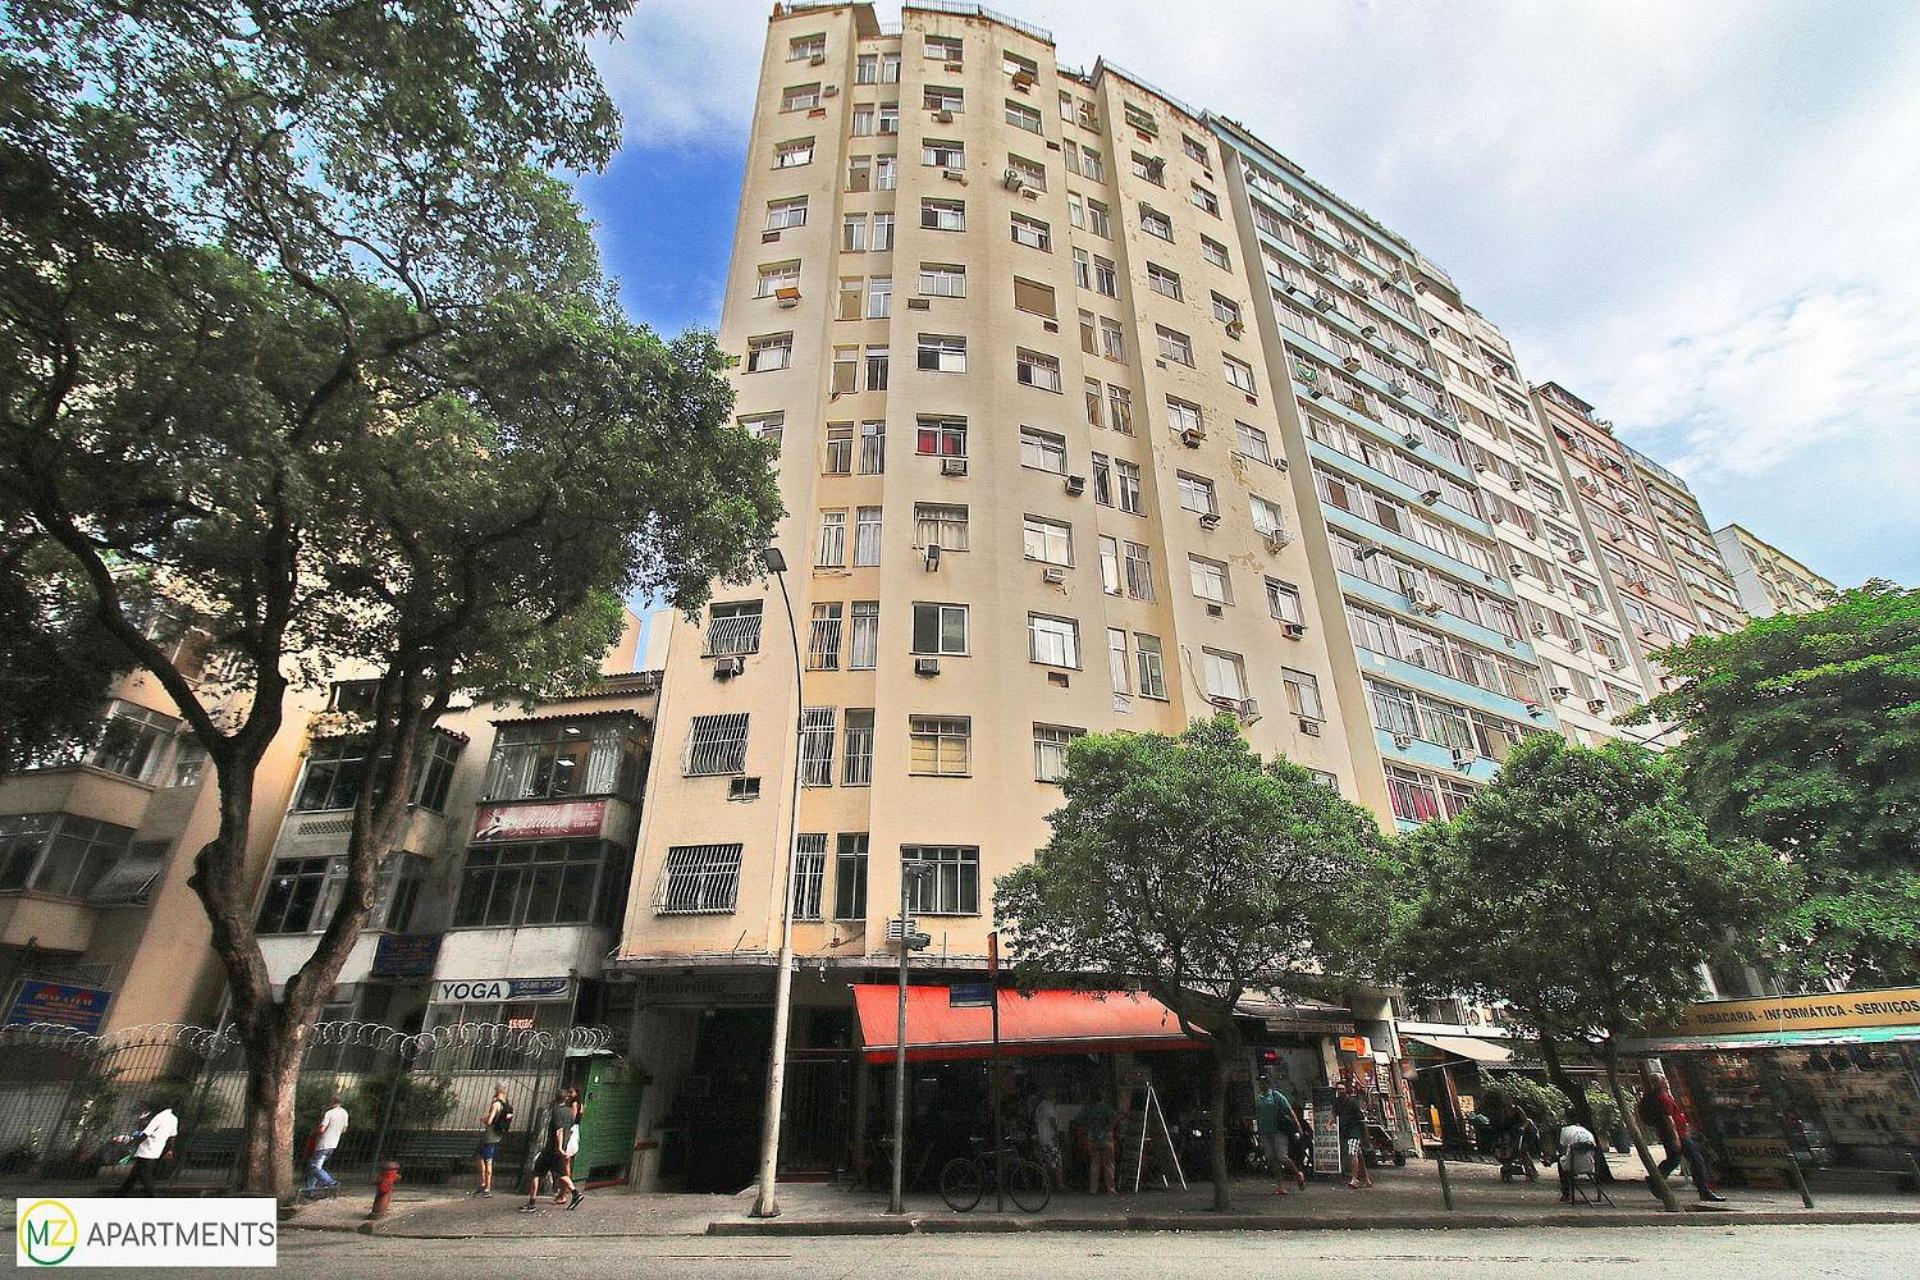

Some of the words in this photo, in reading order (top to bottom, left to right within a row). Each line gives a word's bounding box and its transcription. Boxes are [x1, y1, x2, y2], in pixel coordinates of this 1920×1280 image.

[442, 982, 502, 1000] YOGA
[1697, 1010, 1757, 1025] TABACARIA
[1763, 1004, 1848, 1020] INFORMÁTICA
[1854, 999, 1920, 1015] SERVIÇOS
